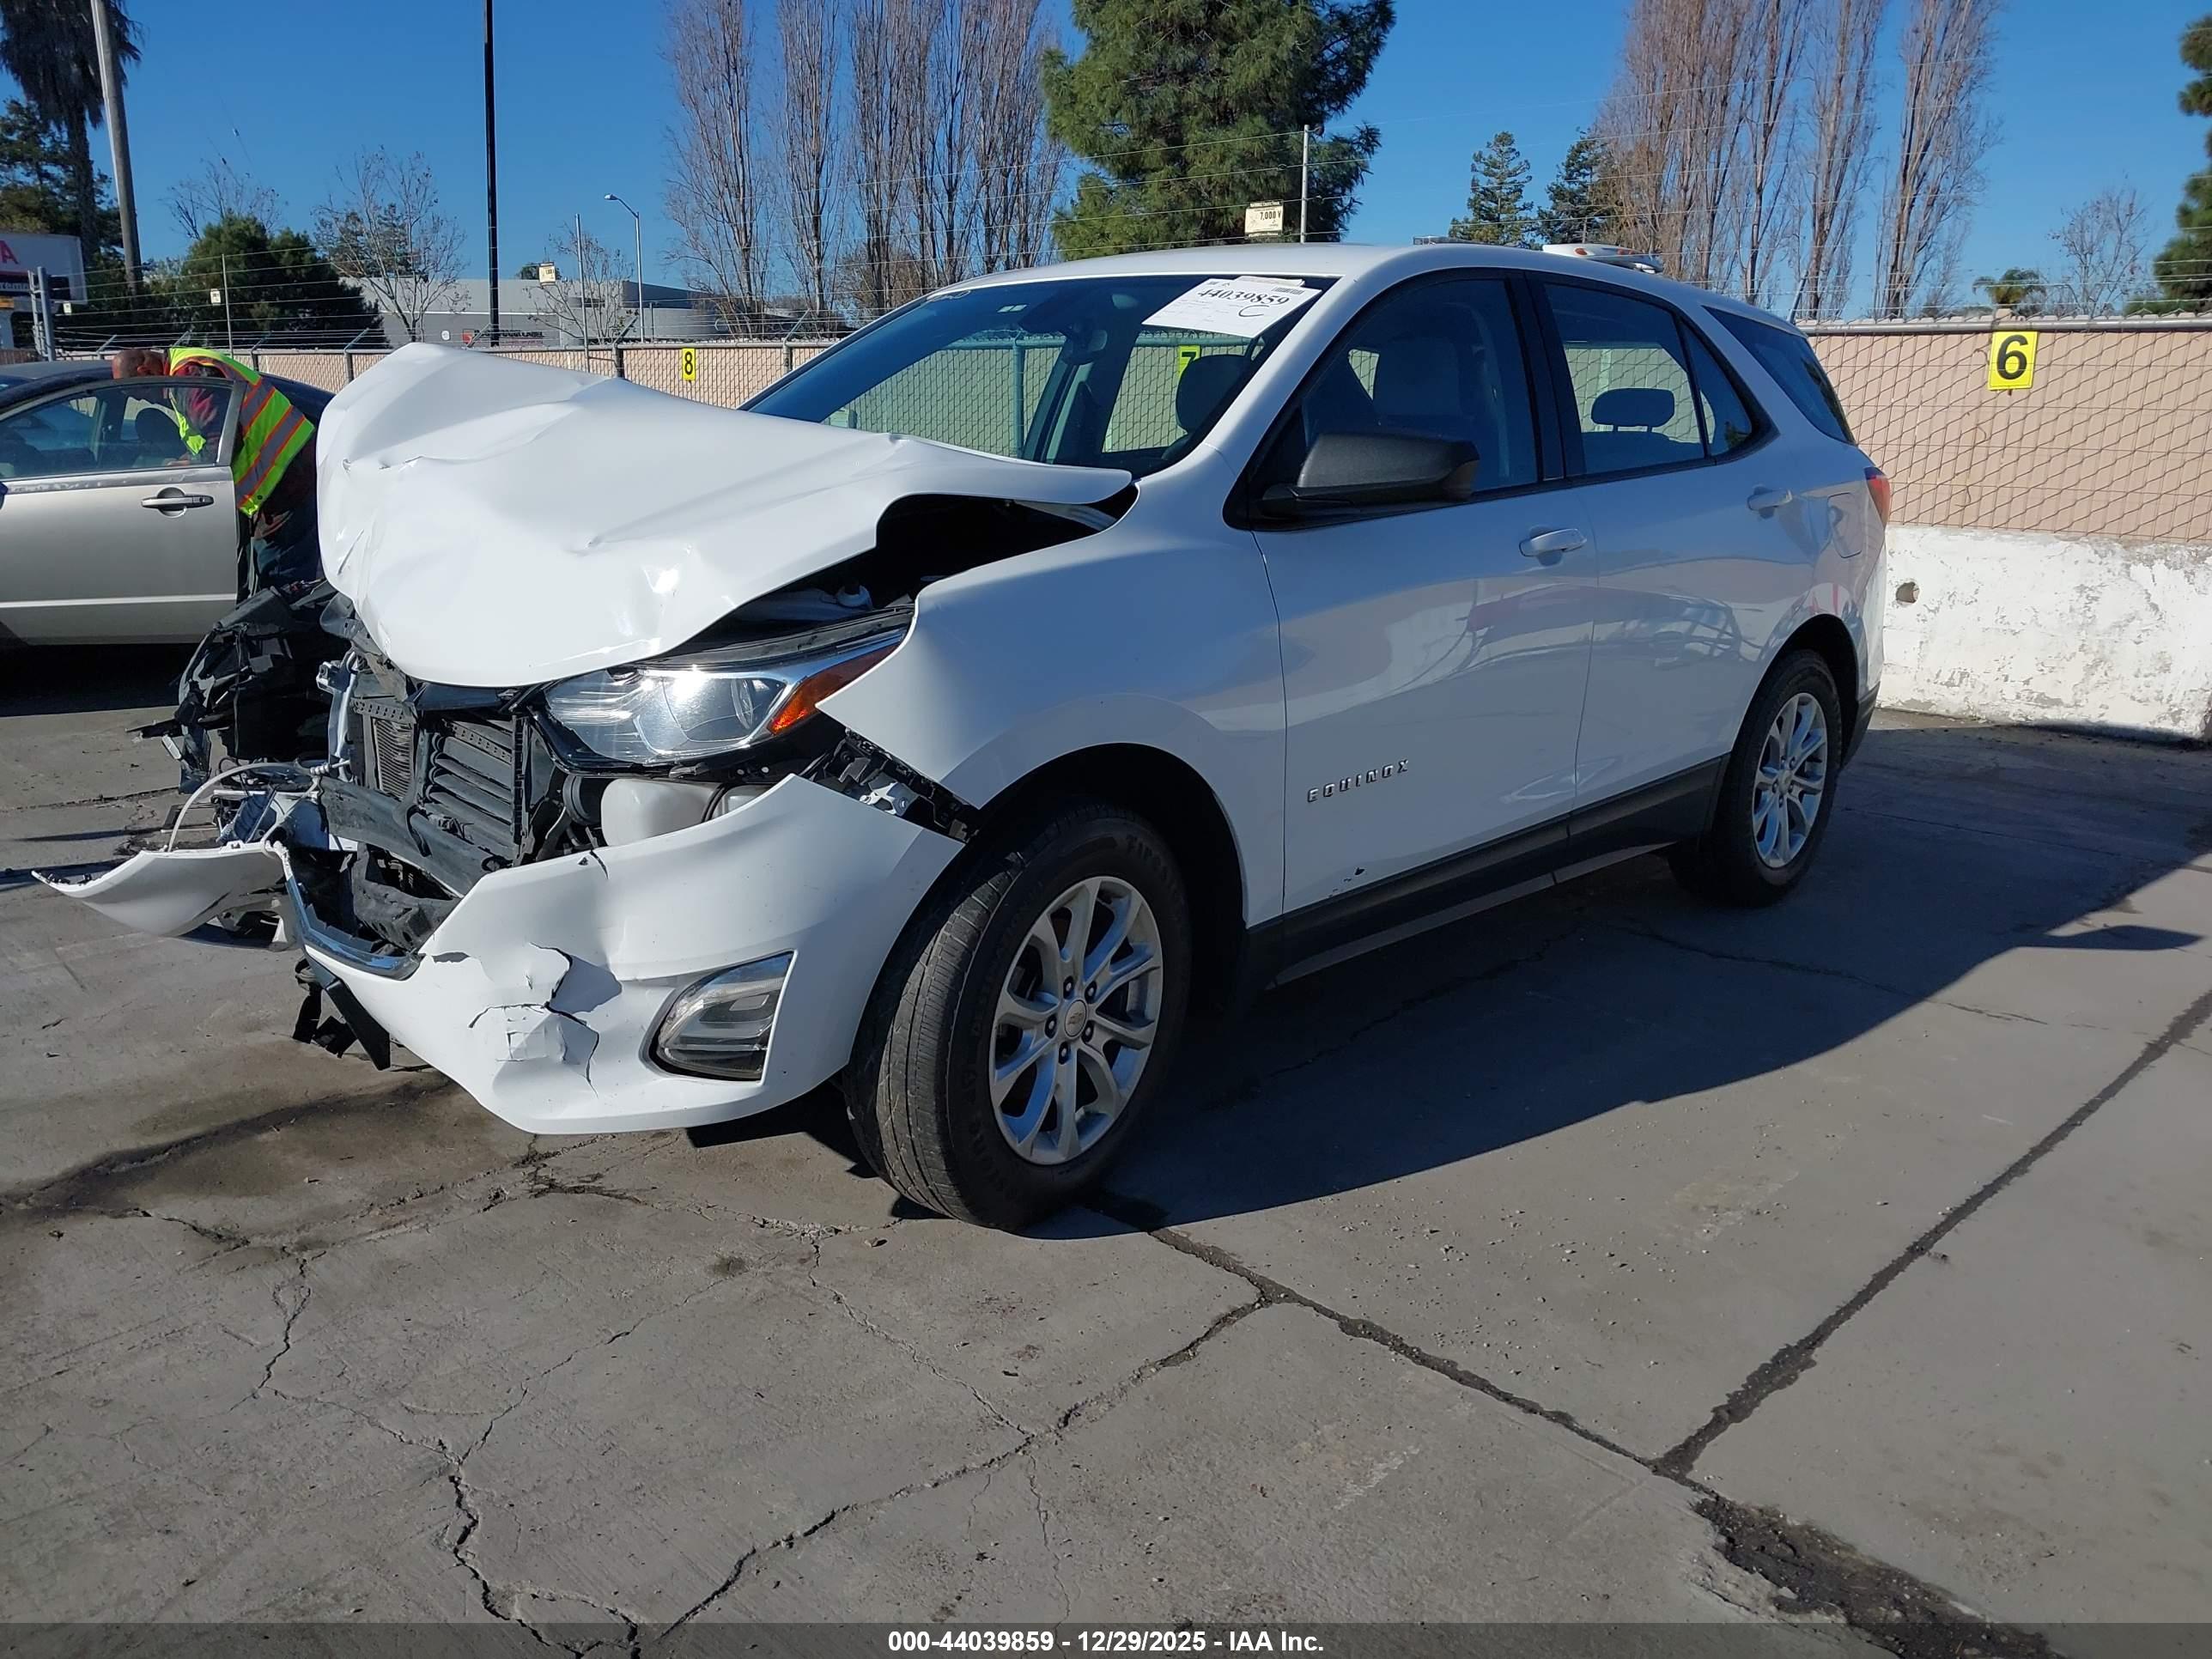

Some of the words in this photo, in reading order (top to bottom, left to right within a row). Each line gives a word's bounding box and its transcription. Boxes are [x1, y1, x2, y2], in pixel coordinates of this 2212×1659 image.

[1198, 289, 1290, 306] 44039859
[1238, 304, 1270, 318] C
[684, 350, 693, 375] 8
[1997, 335, 2028, 380] 6
[1307, 759, 1409, 803] EQUINOX
